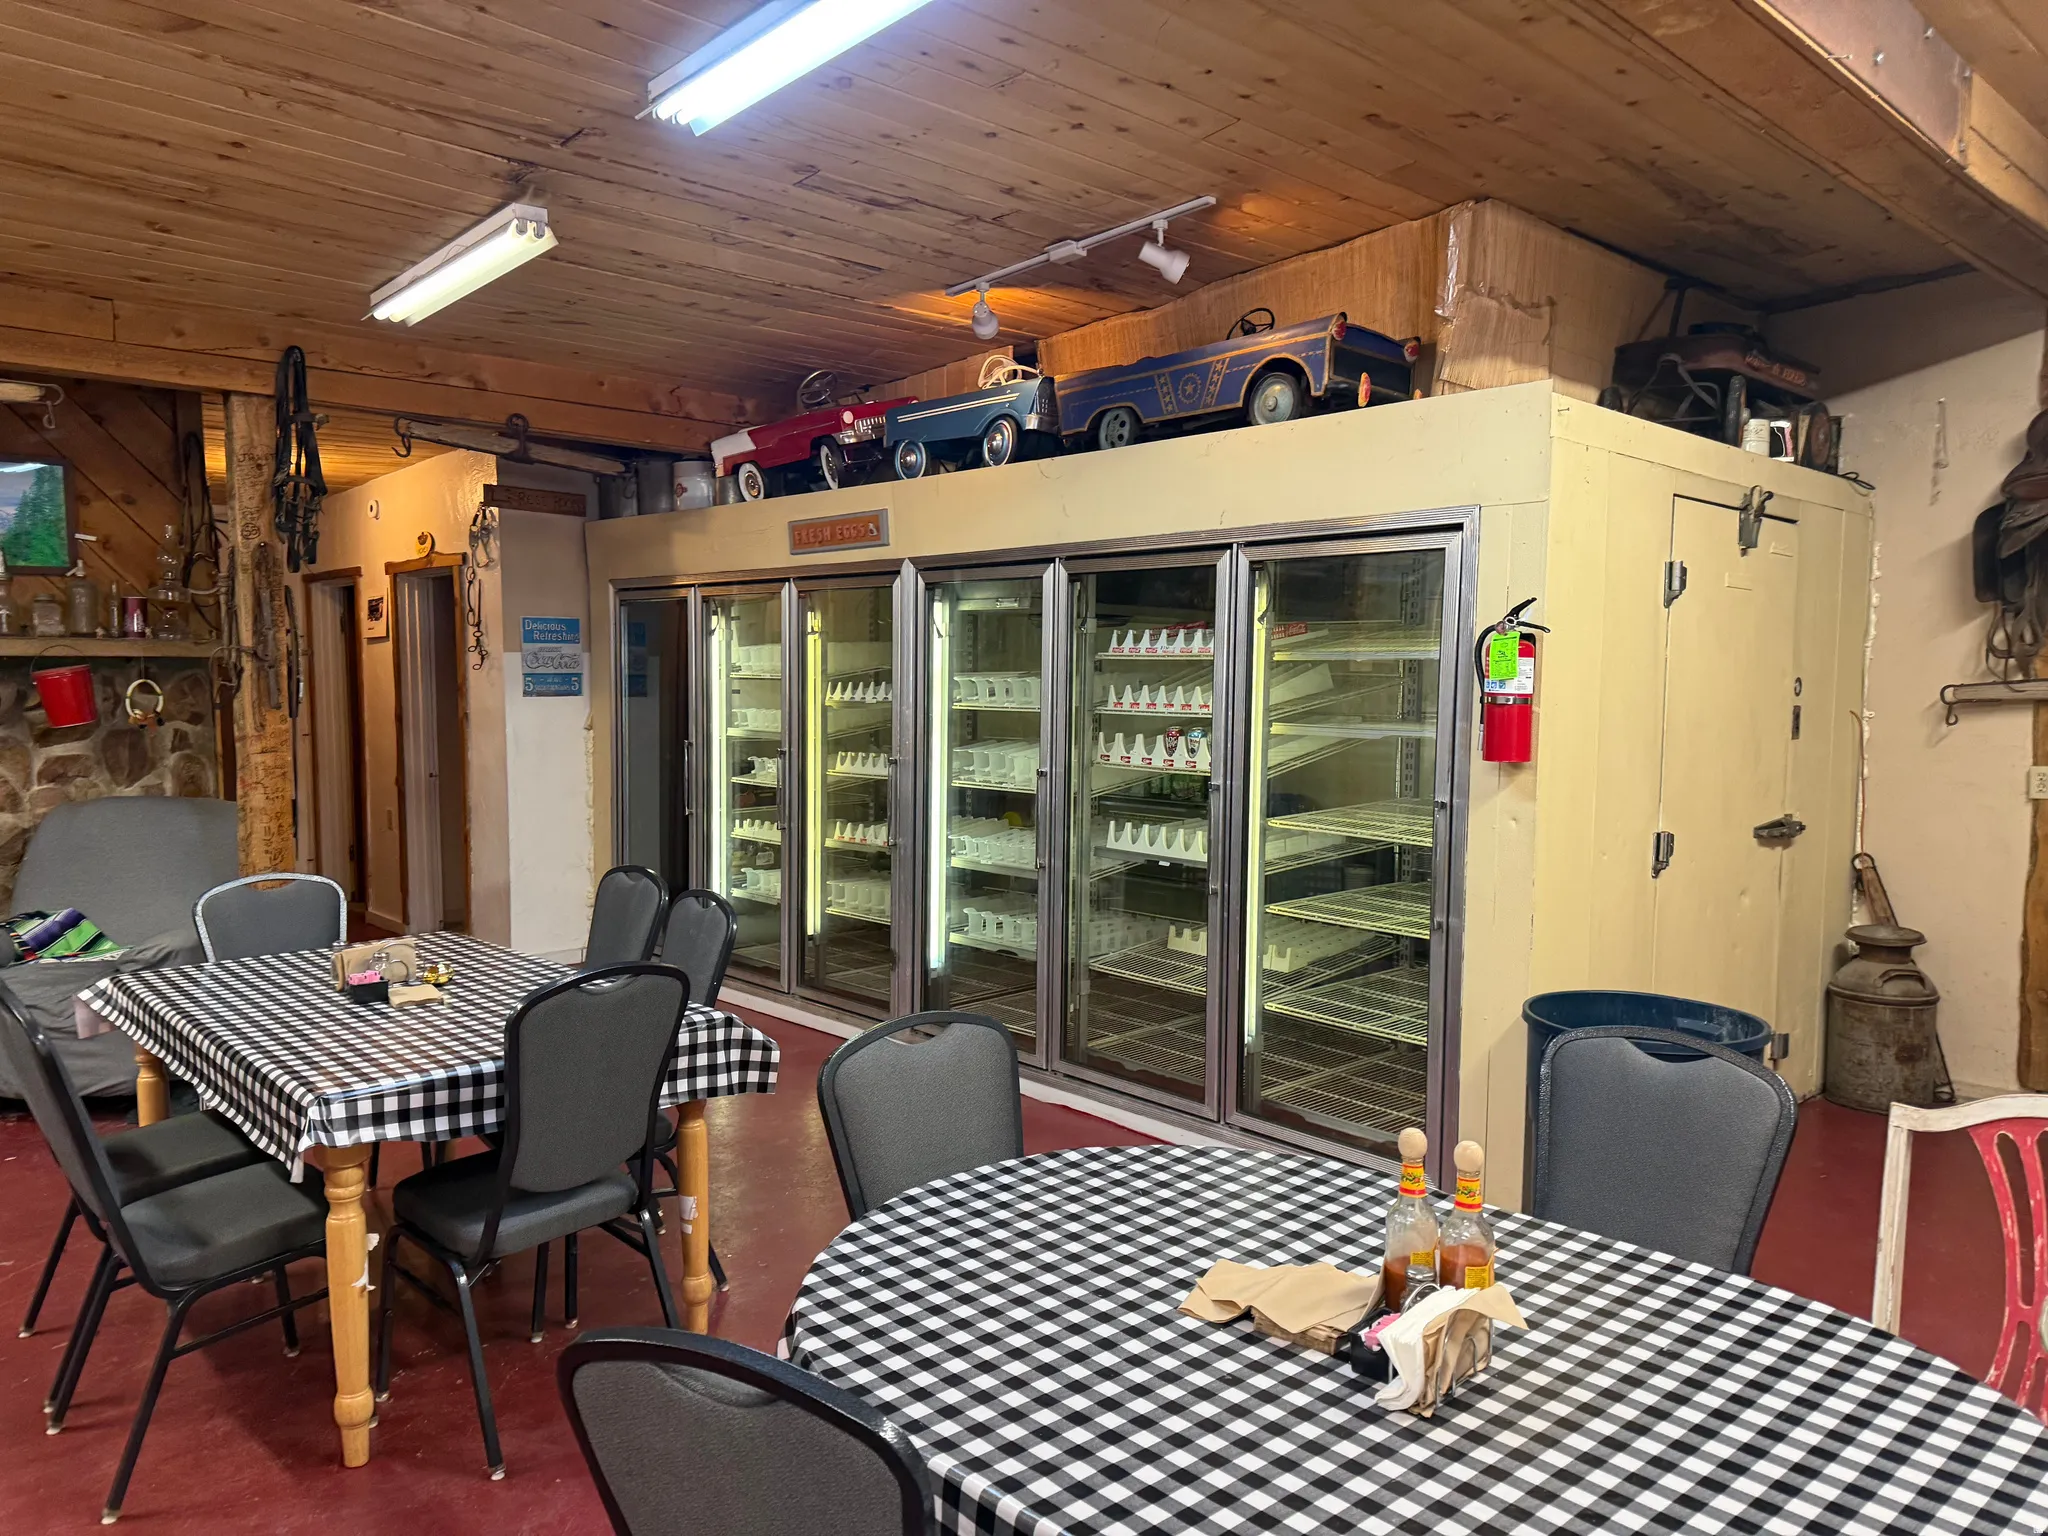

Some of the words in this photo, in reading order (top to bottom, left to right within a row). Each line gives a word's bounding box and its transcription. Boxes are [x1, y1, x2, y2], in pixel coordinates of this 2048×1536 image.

[794, 527, 831, 545] FRESH
[836, 524, 865, 540] EGGS
[525, 619, 567, 631] Delicious
